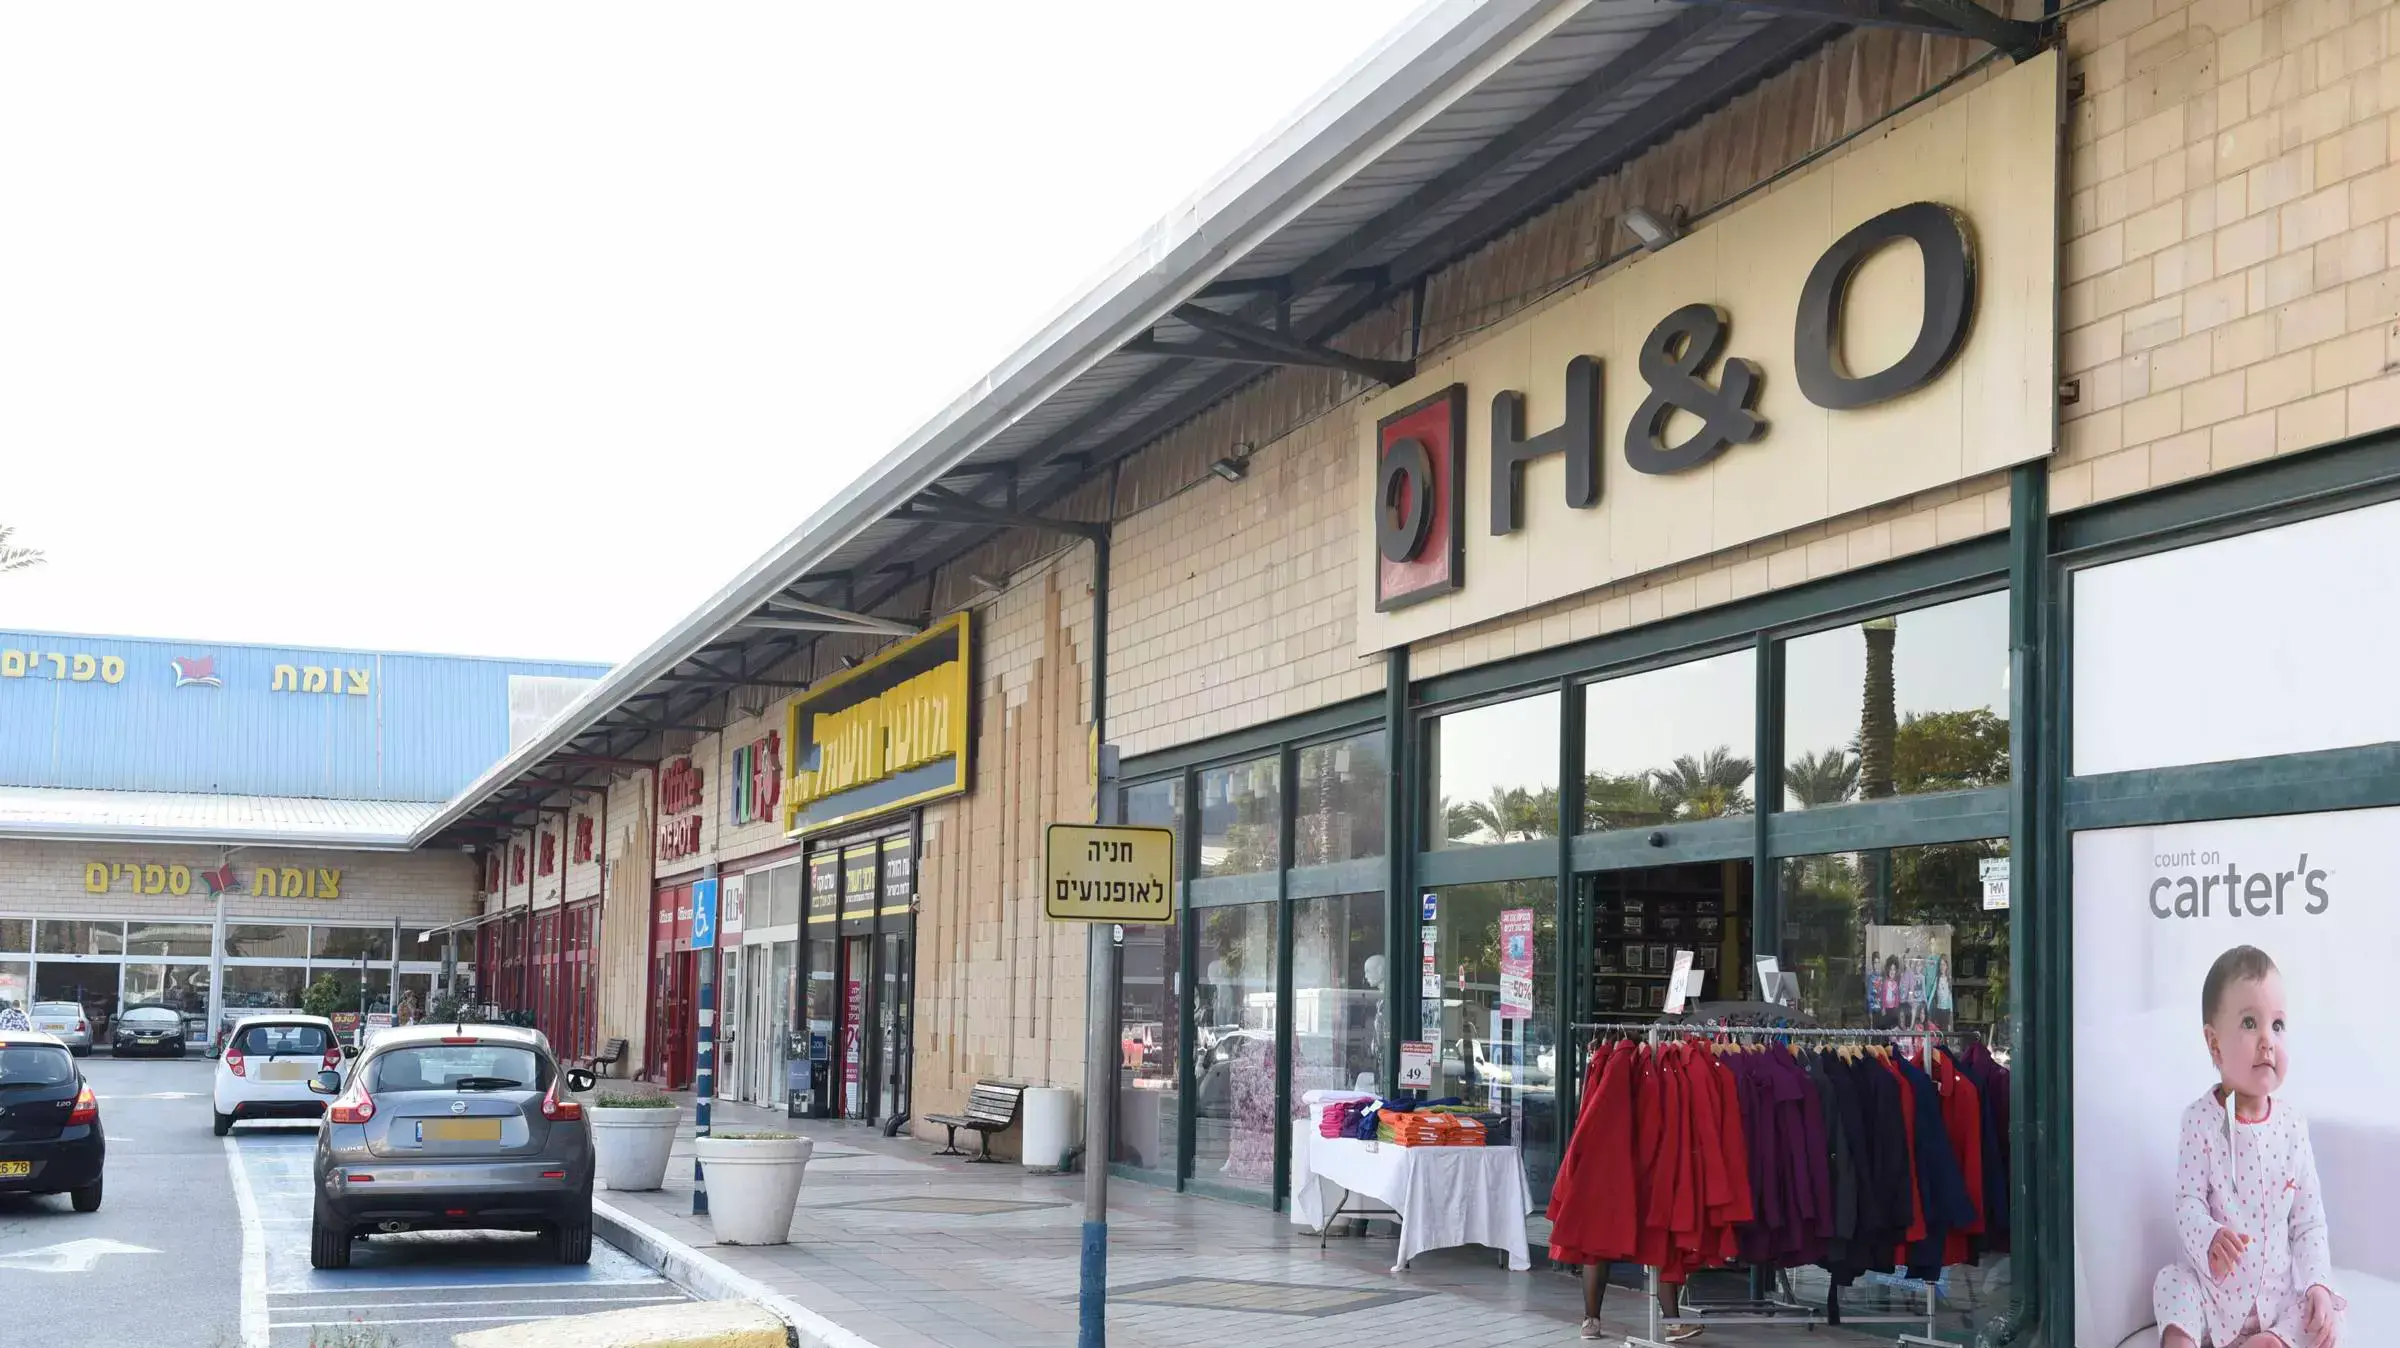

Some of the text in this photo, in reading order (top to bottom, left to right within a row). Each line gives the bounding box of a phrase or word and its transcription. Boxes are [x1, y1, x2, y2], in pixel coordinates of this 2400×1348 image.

[1, 648, 371, 697] צומת ספרים
[660, 757, 704, 816] Office
[658, 814, 703, 861] DEPOT
[1088, 840, 1133, 863] חניה
[2153, 849, 2221, 868] count on
[84, 861, 343, 899] צומת ספרים
[1055, 878, 1164, 904] לאופנועים
[2148, 852, 2330, 919] carter's
[1406, 1068, 1422, 1080] 49
